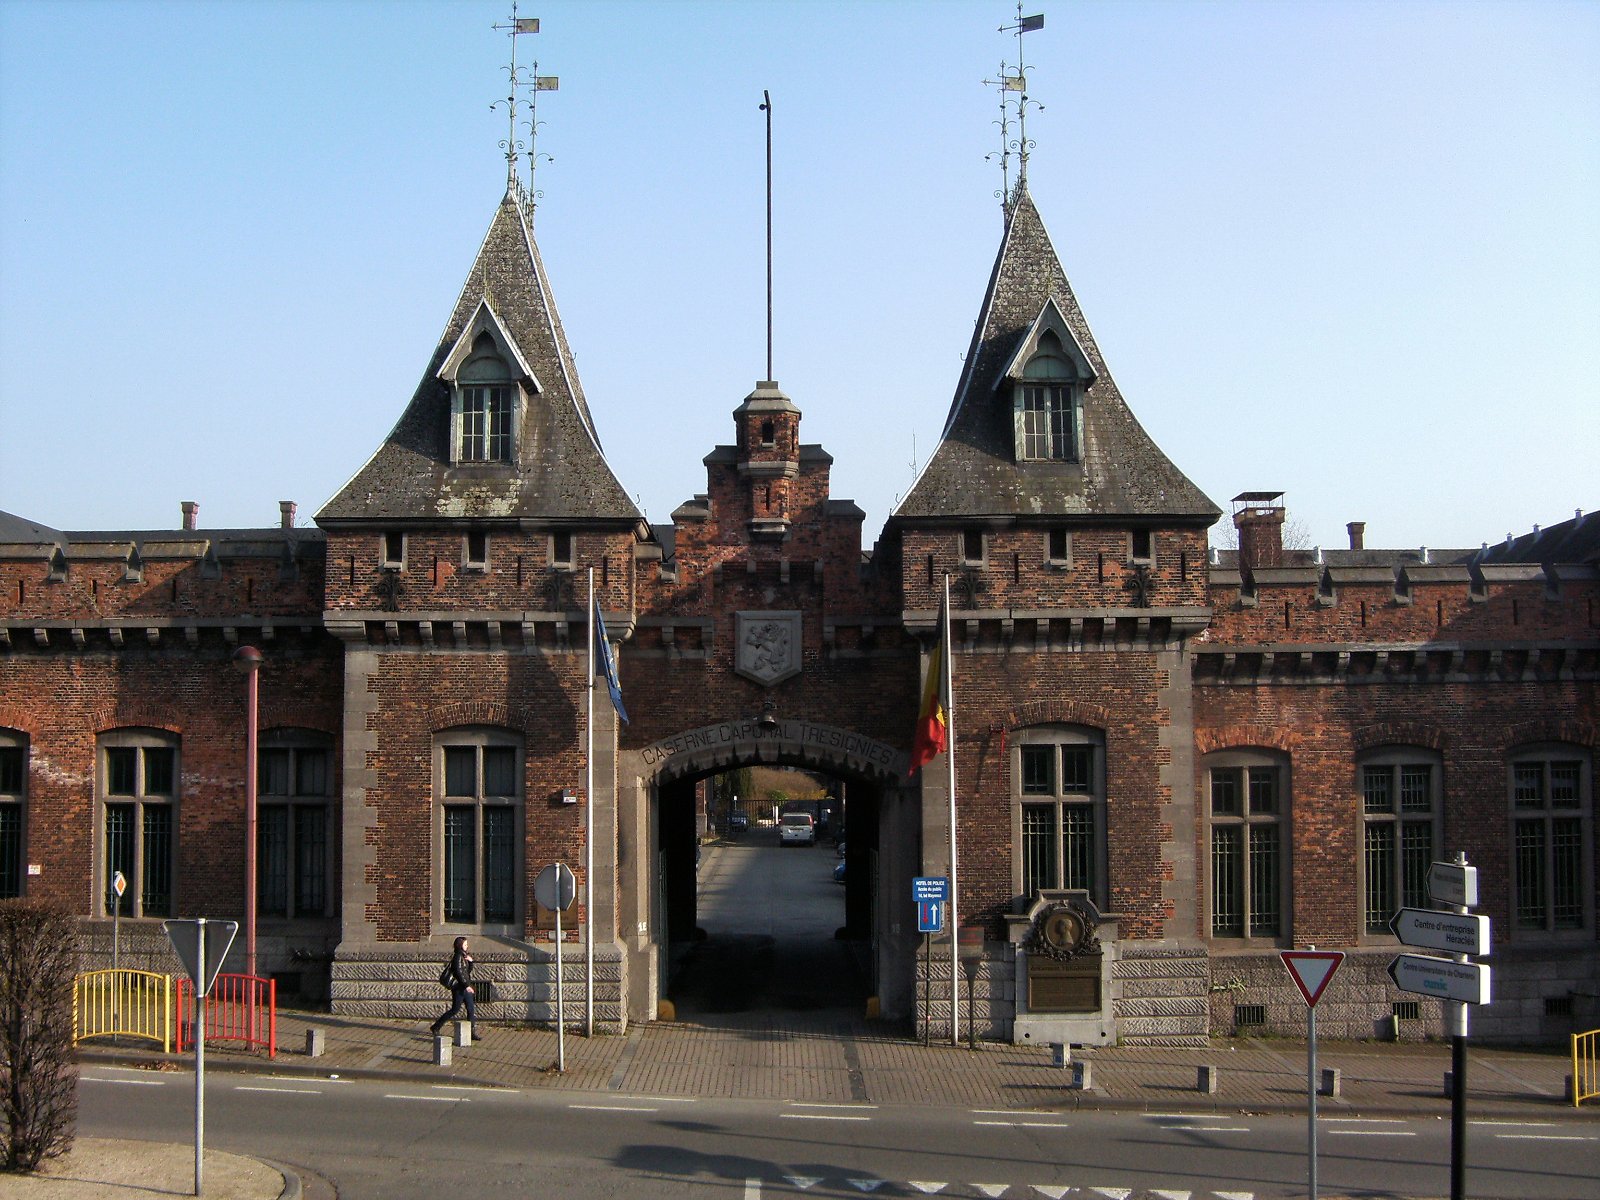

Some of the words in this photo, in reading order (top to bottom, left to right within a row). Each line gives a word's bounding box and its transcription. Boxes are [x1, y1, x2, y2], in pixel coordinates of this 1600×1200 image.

[642, 728, 716, 765] CASERNE
[800, 724, 893, 765] TRESIGNIES
[1414, 918, 1435, 930] Centre
[1436, 921, 1475, 935] d'entreprise
[1403, 961, 1418, 972] Centre
